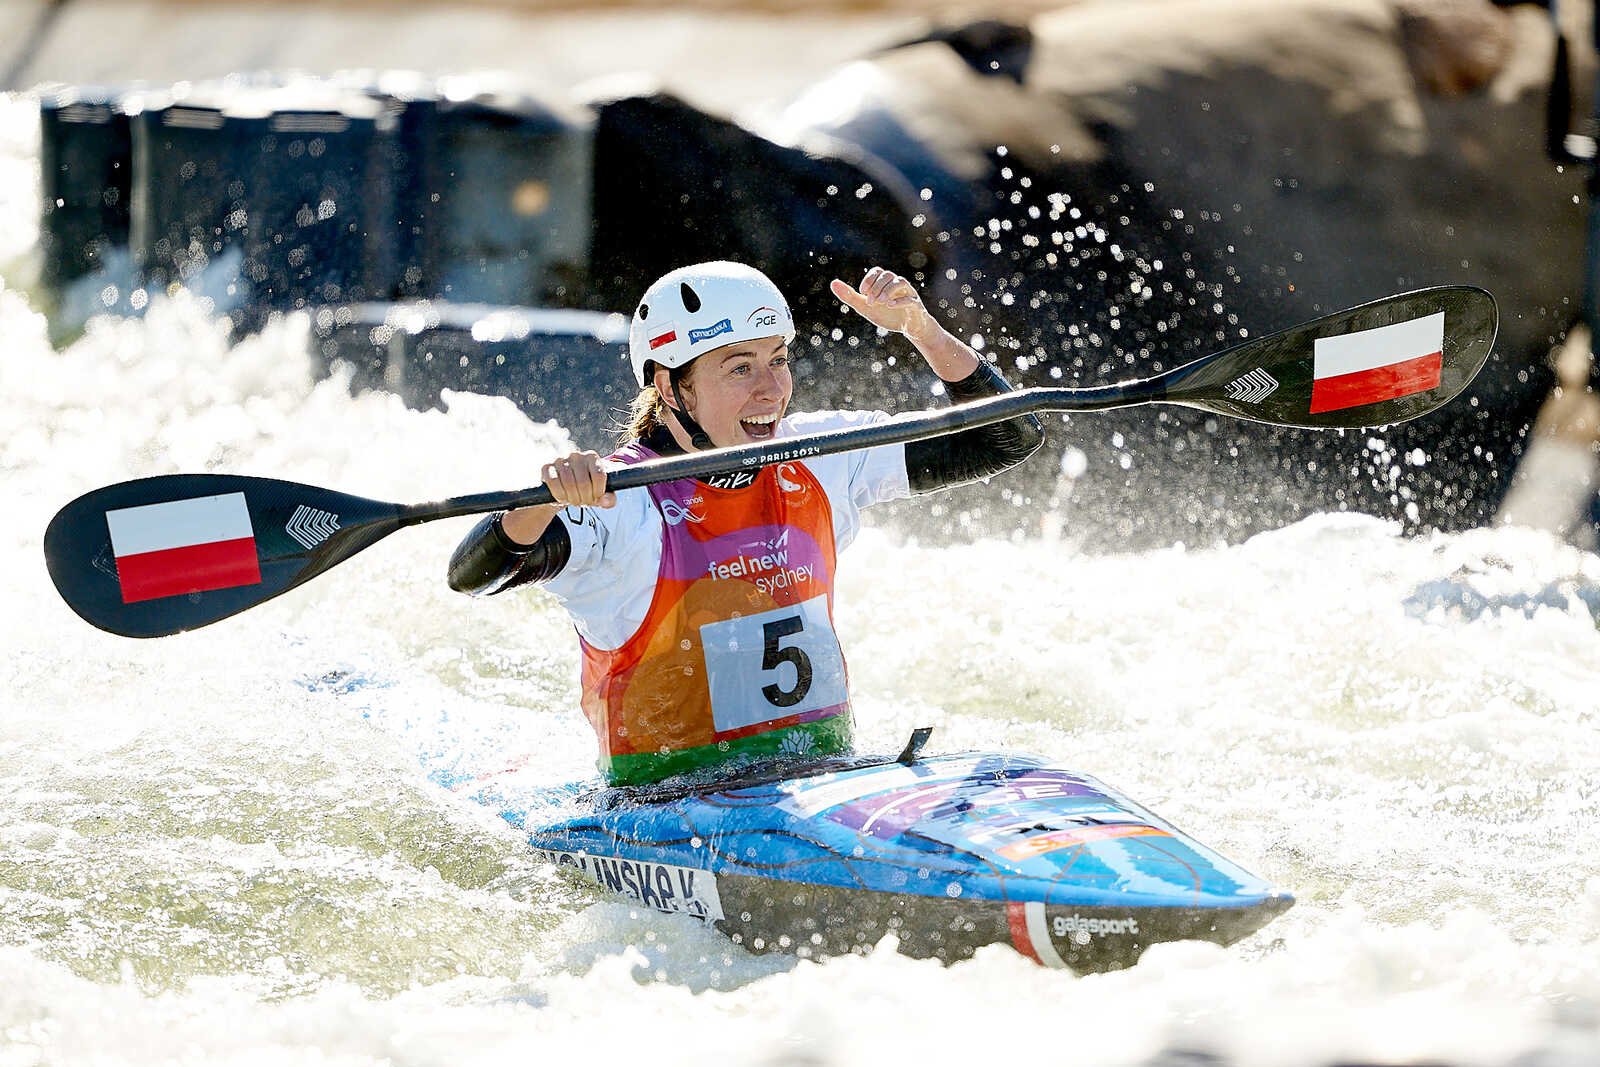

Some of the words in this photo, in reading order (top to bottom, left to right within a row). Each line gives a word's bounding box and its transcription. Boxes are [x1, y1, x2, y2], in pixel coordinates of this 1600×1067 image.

[756, 315, 776, 328] PGE
[760, 451, 790, 464] PARIS
[792, 446, 820, 458] 2024
[708, 555, 748, 582] feel
[749, 550, 788, 574] new
[755, 562, 814, 596] sydney
[761, 615, 813, 708] 5
[1053, 913, 1139, 937] galasport
